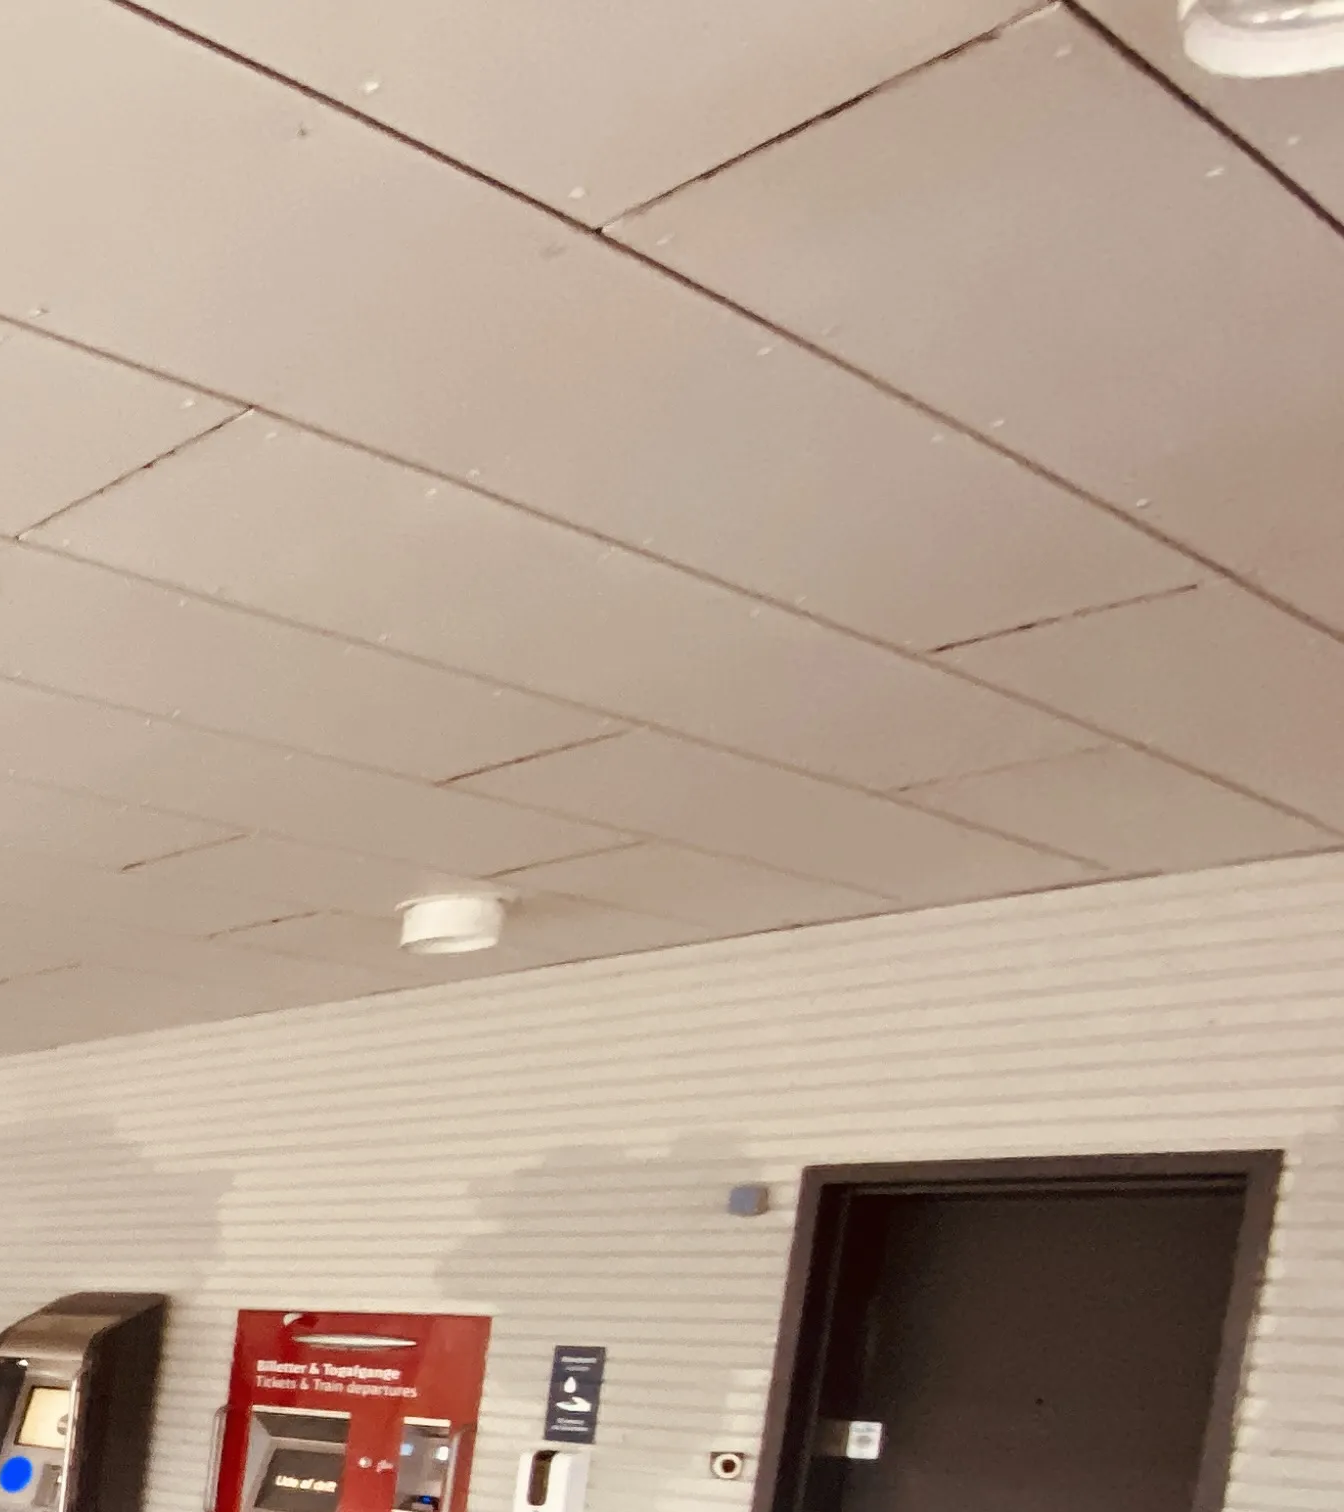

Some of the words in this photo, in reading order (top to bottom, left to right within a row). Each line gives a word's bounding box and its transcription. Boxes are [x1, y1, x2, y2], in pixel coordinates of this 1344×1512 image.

[257, 1360, 307, 1374] Billetter
[308, 1362, 320, 1375] &
[256, 1375, 297, 1389] Tickets
[299, 1377, 310, 1390] &
[312, 1379, 344, 1393] Train
[346, 1380, 418, 1398] departures
